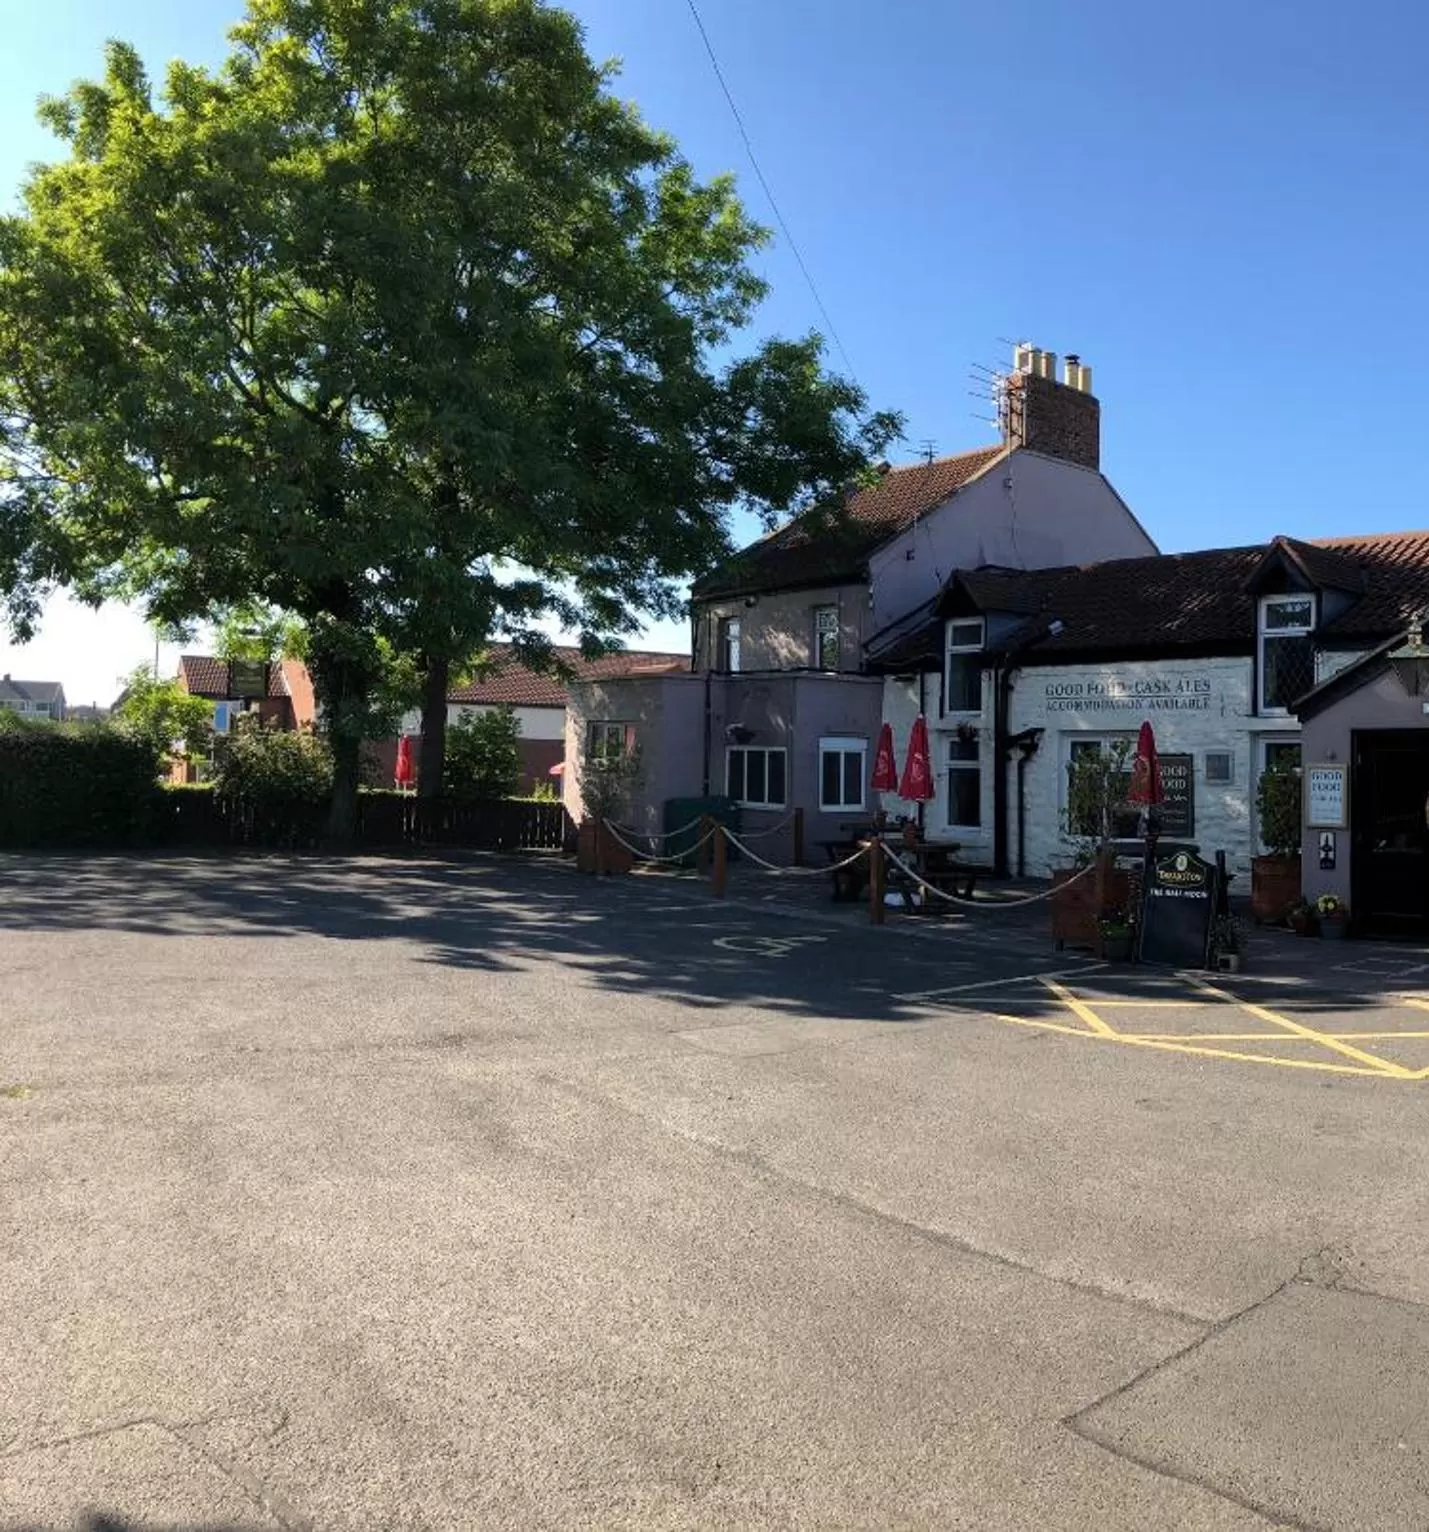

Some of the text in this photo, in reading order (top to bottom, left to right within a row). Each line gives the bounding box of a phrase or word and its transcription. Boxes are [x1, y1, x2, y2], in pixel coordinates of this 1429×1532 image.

[1045, 683, 1083, 697] GOOD
[1134, 680, 1171, 695] CASK
[1175, 679, 1212, 694] ALES
[1149, 698, 1211, 711] AVAILABLE
[1160, 779, 1186, 790] OOD
